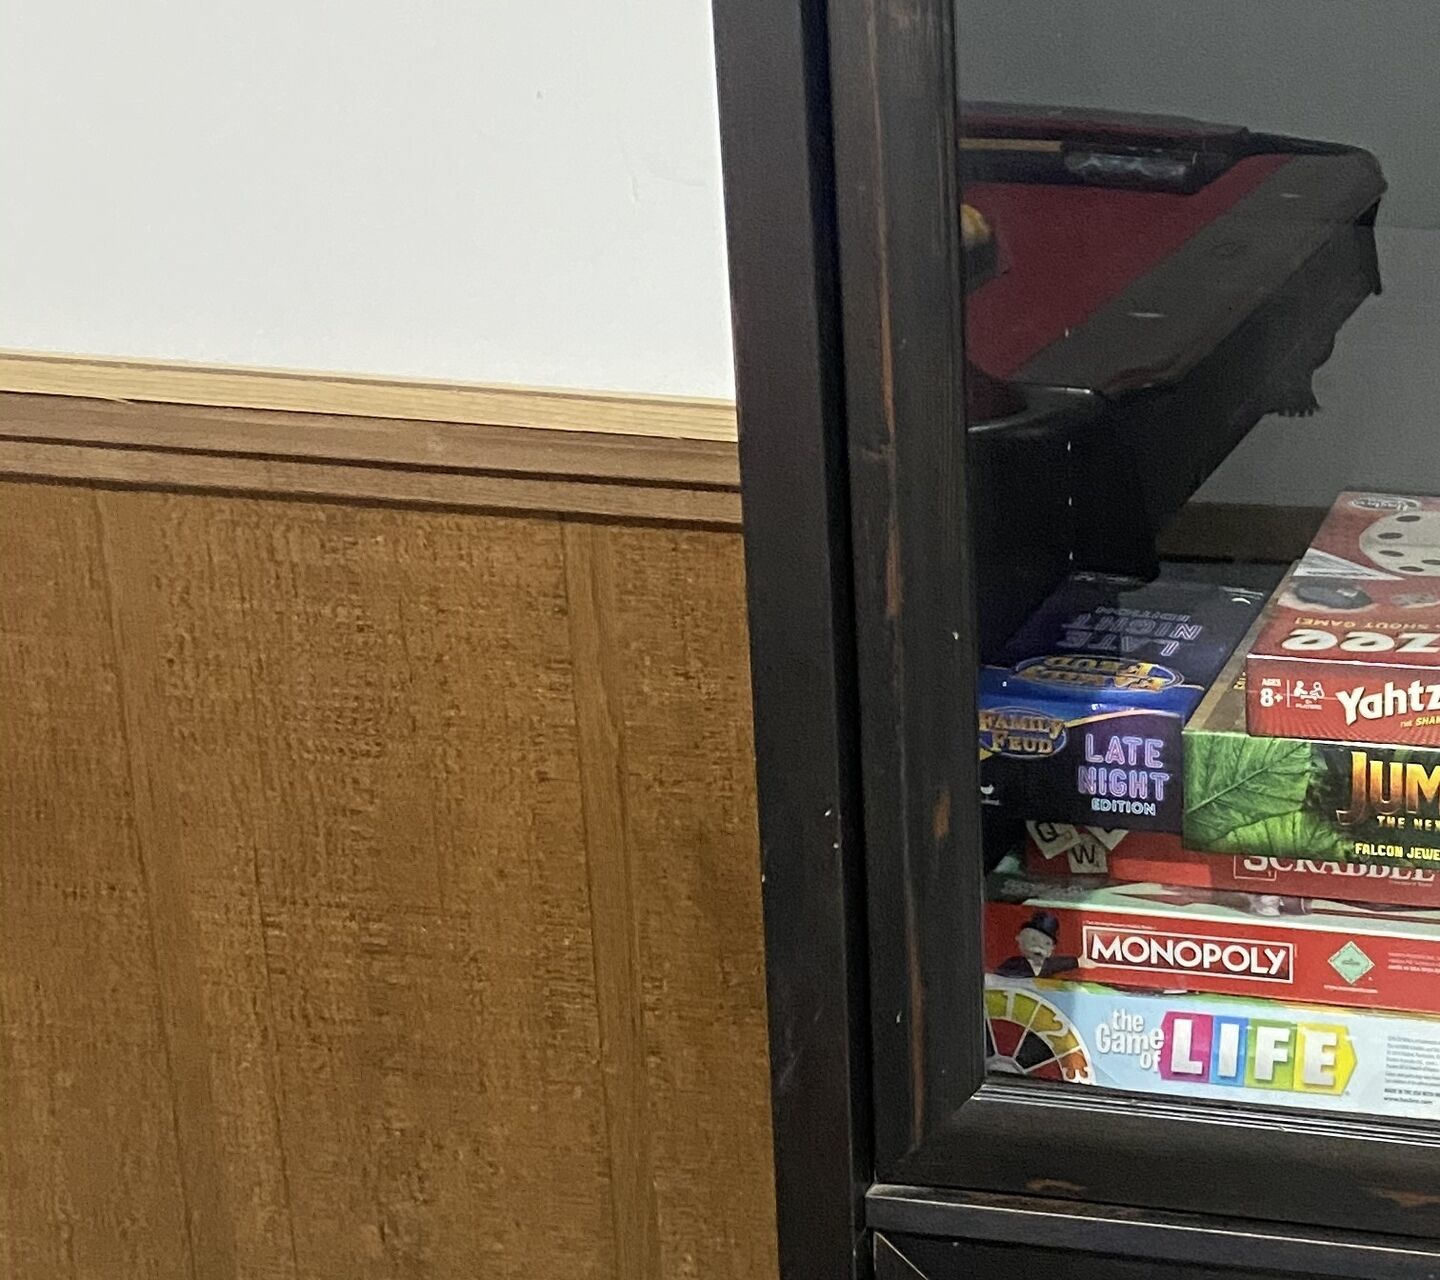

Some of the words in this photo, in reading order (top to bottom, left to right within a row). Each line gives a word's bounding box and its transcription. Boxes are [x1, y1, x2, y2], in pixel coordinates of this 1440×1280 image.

[1260, 687, 1284, 707] 8+
[992, 730, 1054, 752] FEUD
[1085, 733, 1164, 768] LATE
[1078, 765, 1170, 801] NIGHT
[1091, 797, 1156, 816] EDITION
[1377, 815, 1405, 829] THE
[1071, 844, 1096, 865] W
[1355, 842, 1405, 858] FALCON
[1091, 933, 1287, 975] MONOPOLY
[1112, 1008, 1144, 1033] the
[1095, 1023, 1164, 1055] Game
[1140, 1049, 1161, 1072] of
[1171, 1018, 1338, 1086] LIFE
